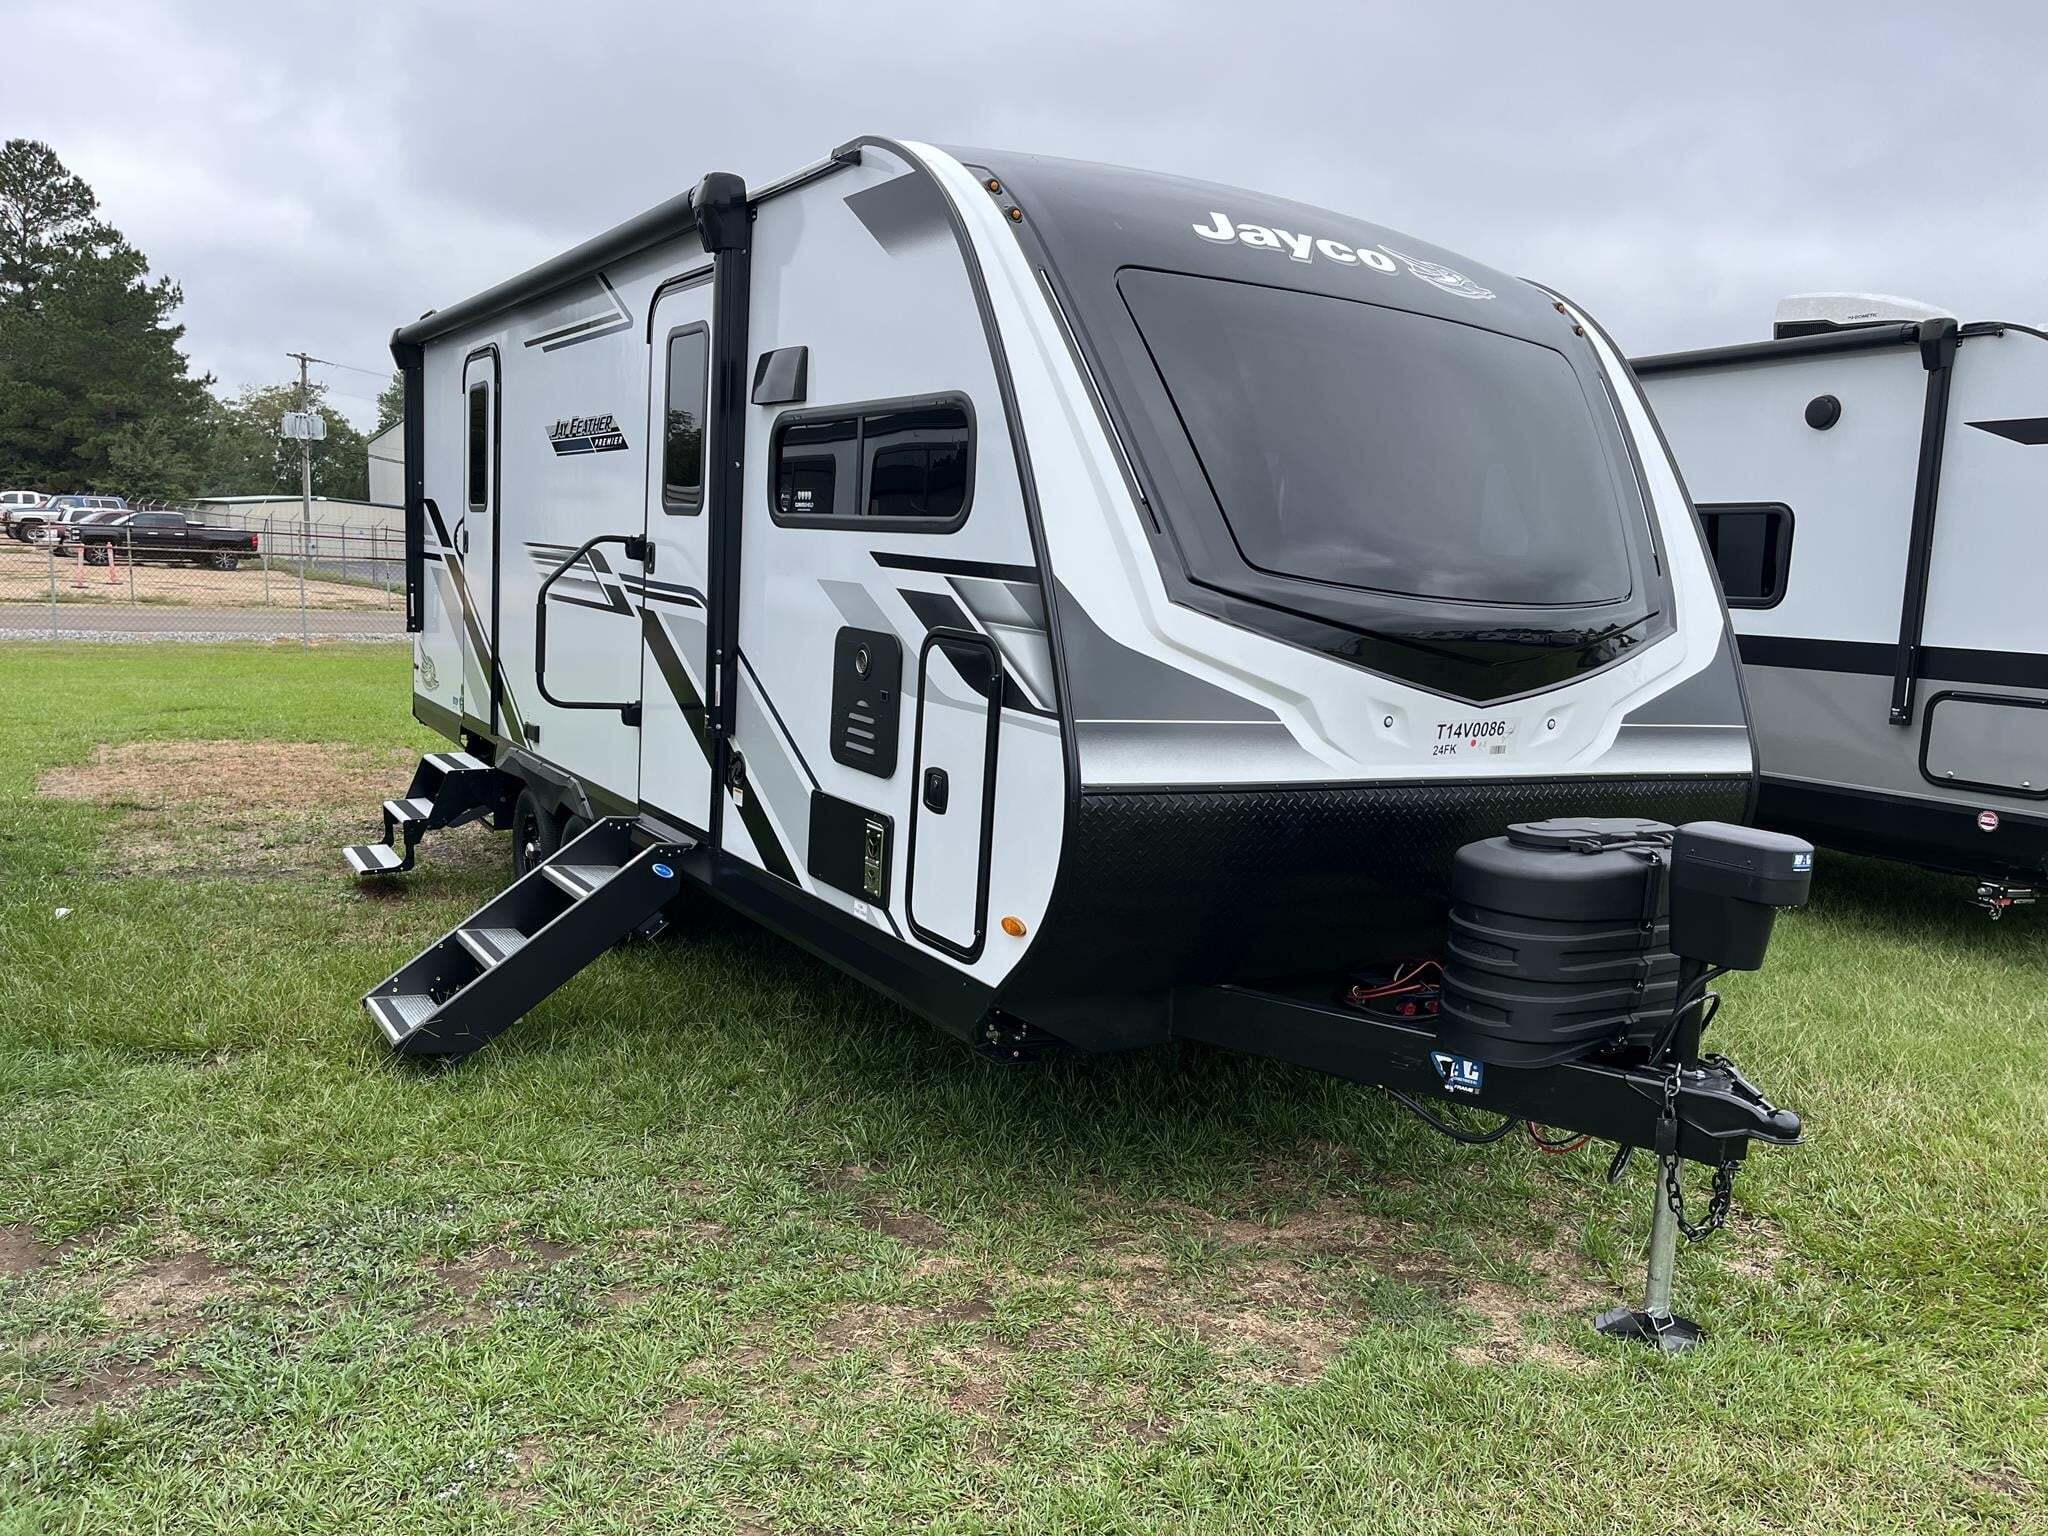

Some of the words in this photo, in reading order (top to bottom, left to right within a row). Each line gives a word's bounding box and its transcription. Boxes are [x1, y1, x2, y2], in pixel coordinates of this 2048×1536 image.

[1192, 211, 1398, 275] Jayco
[594, 436, 624, 447] PREMIER
[1437, 721, 1505, 740] T14V0086
[1432, 744, 1457, 756] 24FK
